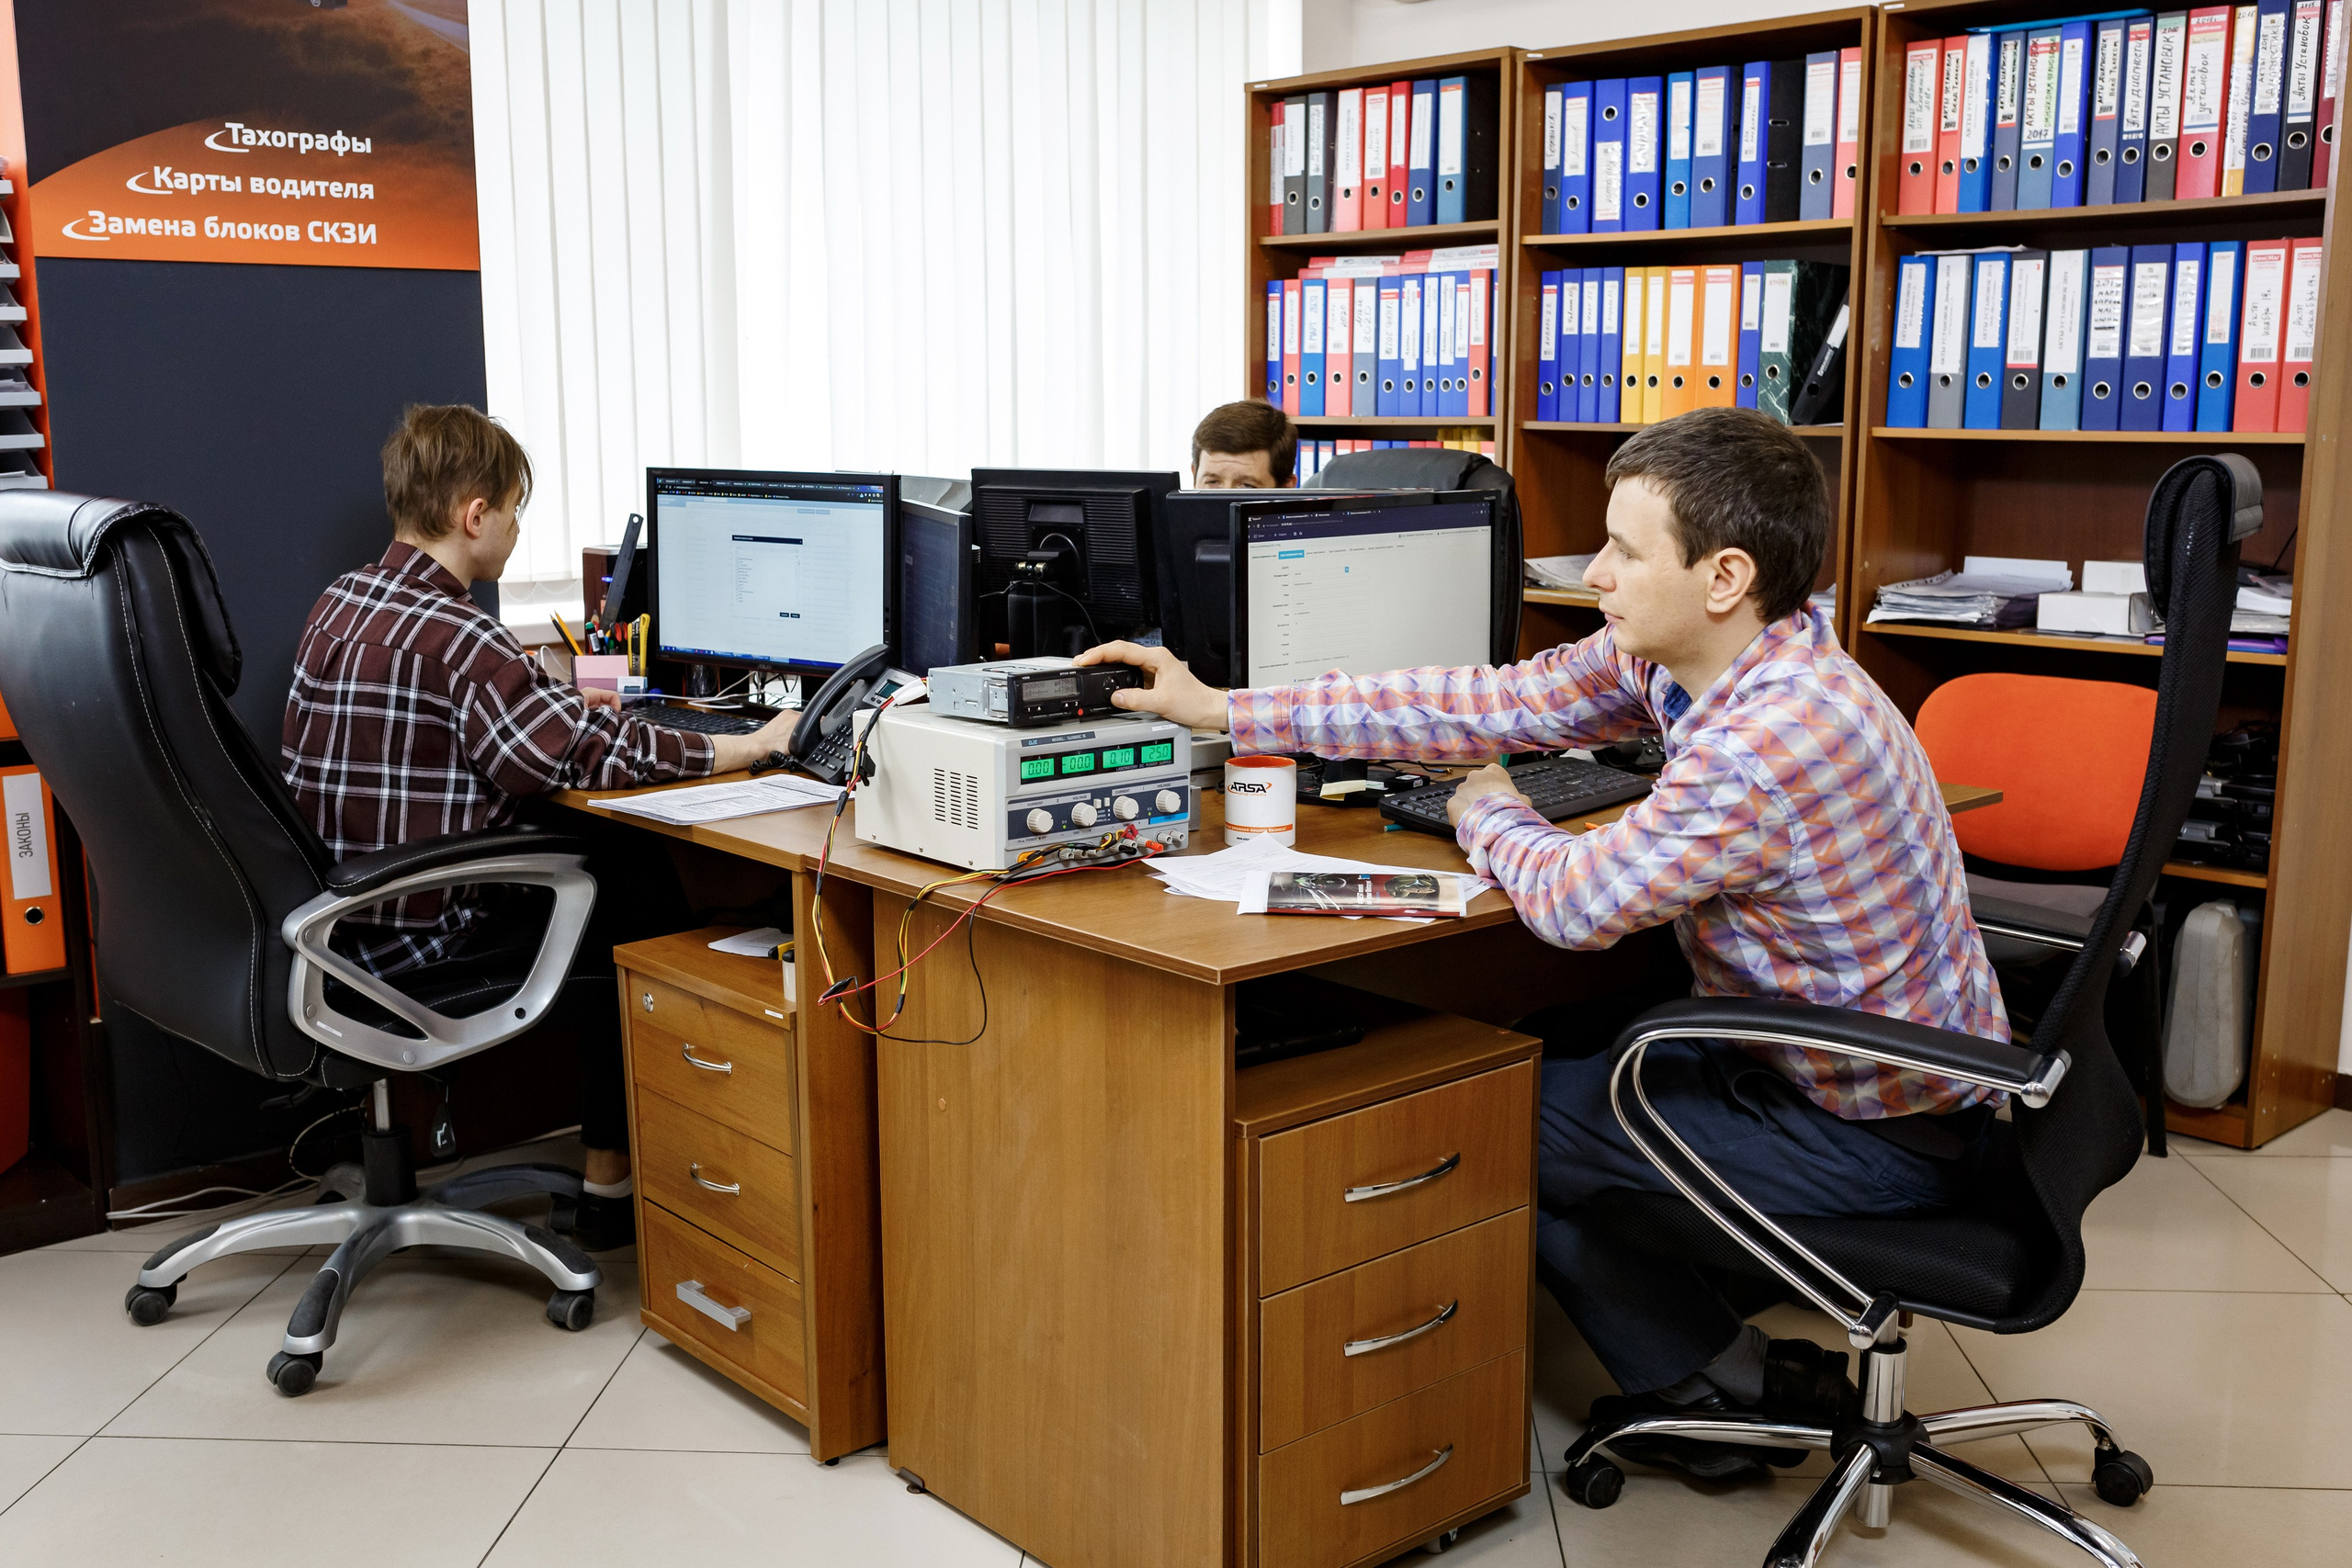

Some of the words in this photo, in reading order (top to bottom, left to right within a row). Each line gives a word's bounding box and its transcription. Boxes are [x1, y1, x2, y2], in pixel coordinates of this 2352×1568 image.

[2028, 38, 2039, 94] УСТАНОВОК
[2157, 35, 2175, 99] УСТАНОВОК
[1967, 59, 1975, 110] УСТАНОВОК
[2026, 97, 2035, 127] АКТЫ
[2155, 106, 2170, 135] АКТЫ
[225, 122, 371, 156] Тахографы
[2027, 129, 2049, 140] 2017
[153, 165, 242, 195] Карты
[250, 175, 374, 199] водителя
[87, 210, 197, 238] Замена
[204, 217, 300, 242] блоков
[307, 221, 377, 244] СКЗИ
[1363, 305, 1372, 343] 2020
[1027, 761, 1049, 776] 0.00
[1110, 750, 1130, 765] 0.10
[1148, 745, 1169, 760] 25.0
[1230, 781, 1267, 793] ARSA
[16, 812, 33, 858] ЗАКОНЫ
